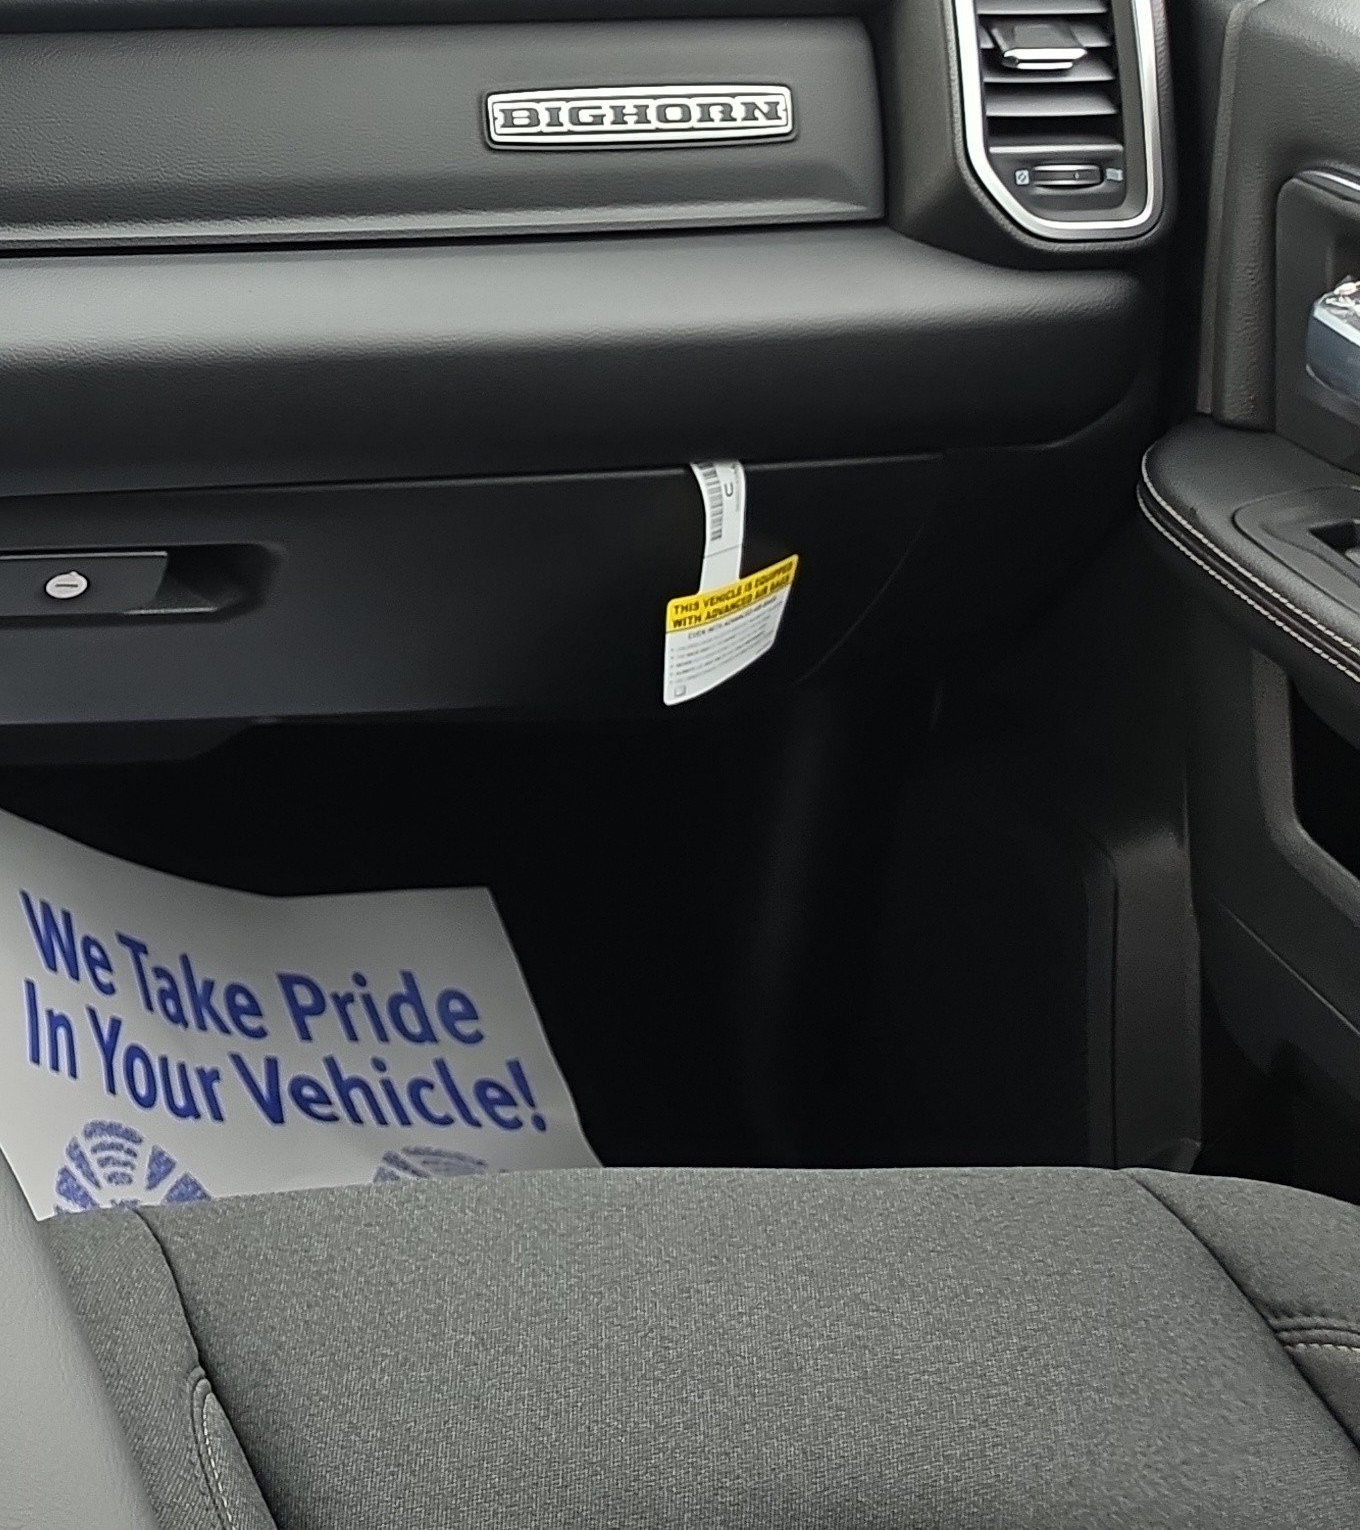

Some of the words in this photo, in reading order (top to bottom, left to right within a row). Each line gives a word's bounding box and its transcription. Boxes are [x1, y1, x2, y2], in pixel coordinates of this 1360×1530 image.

[499, 100, 782, 130] BIGHORN
[672, 615, 702, 629] WITH
[706, 594, 753, 620] ADVANCED
[674, 600, 700, 615] THIS
[704, 585, 742, 608] VEHICLE
[20, 888, 116, 998] We
[115, 929, 270, 1041] Take
[277, 969, 485, 1045] Pride
[24, 978, 78, 1081] In
[86, 1003, 226, 1124] Your
[229, 1051, 548, 1134] Vehicle!
